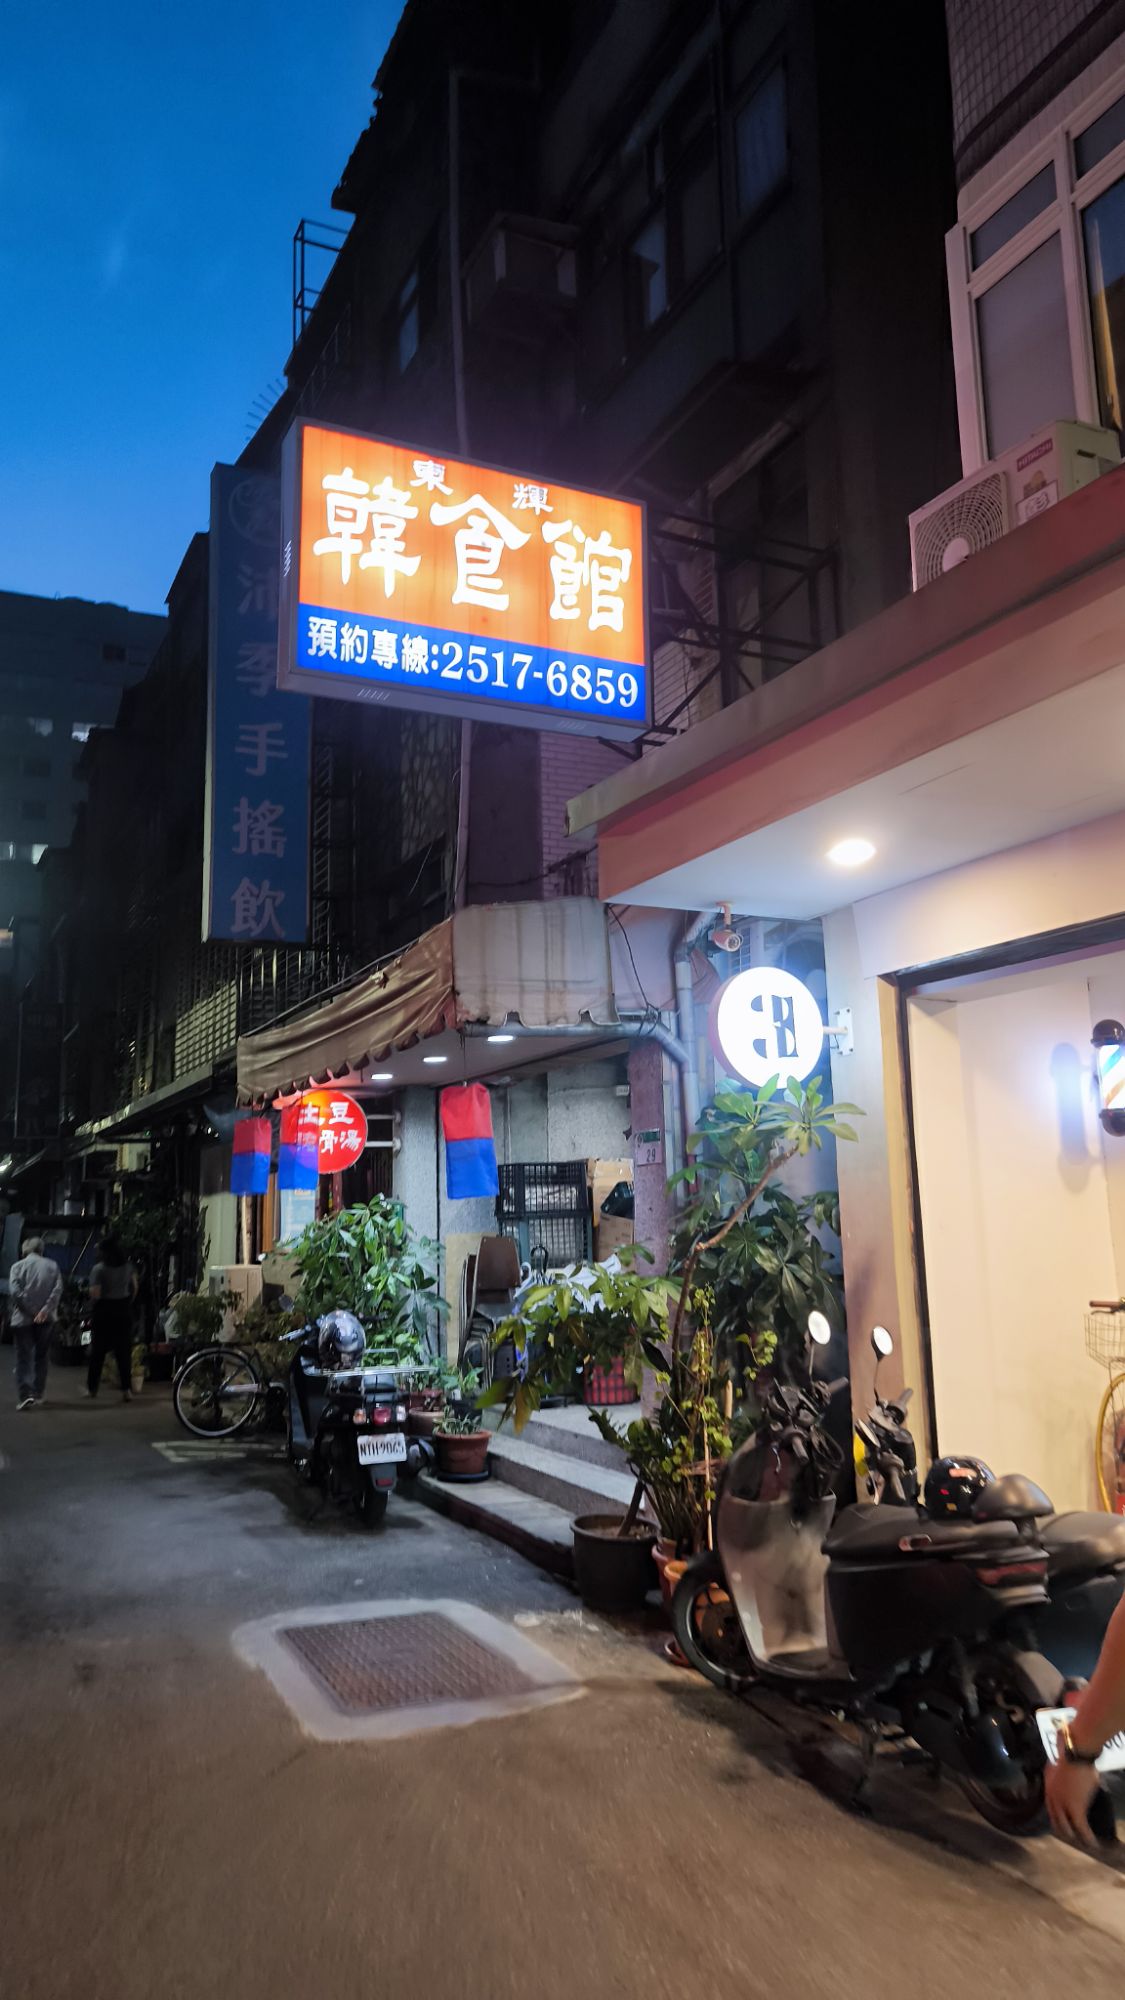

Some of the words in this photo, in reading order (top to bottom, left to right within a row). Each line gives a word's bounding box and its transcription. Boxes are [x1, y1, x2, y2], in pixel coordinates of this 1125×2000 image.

[409, 460, 554, 515] 東輝
[313, 467, 632, 633] 韓食館
[298, 1101, 355, 1126] 土豆
[646, 1148, 656, 1162] 29
